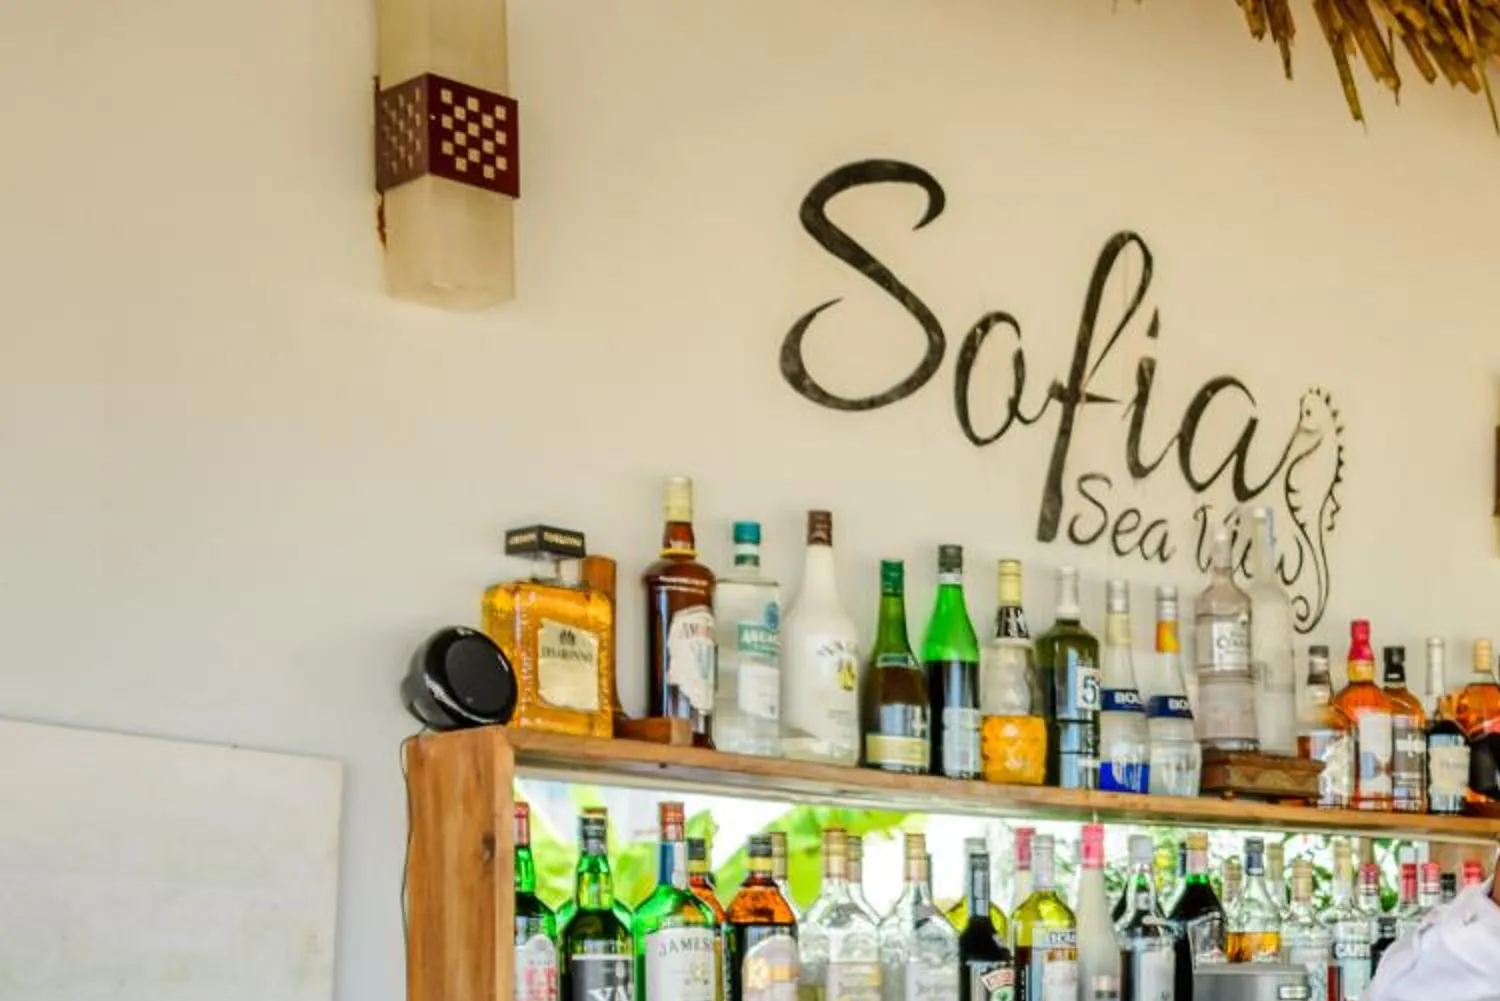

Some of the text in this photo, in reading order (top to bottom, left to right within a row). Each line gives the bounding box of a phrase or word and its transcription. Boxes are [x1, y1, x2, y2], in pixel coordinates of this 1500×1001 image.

[779, 158, 1300, 543] Sofia
[1068, 473, 1176, 565] Sea
[1168, 698, 1190, 711] BO
